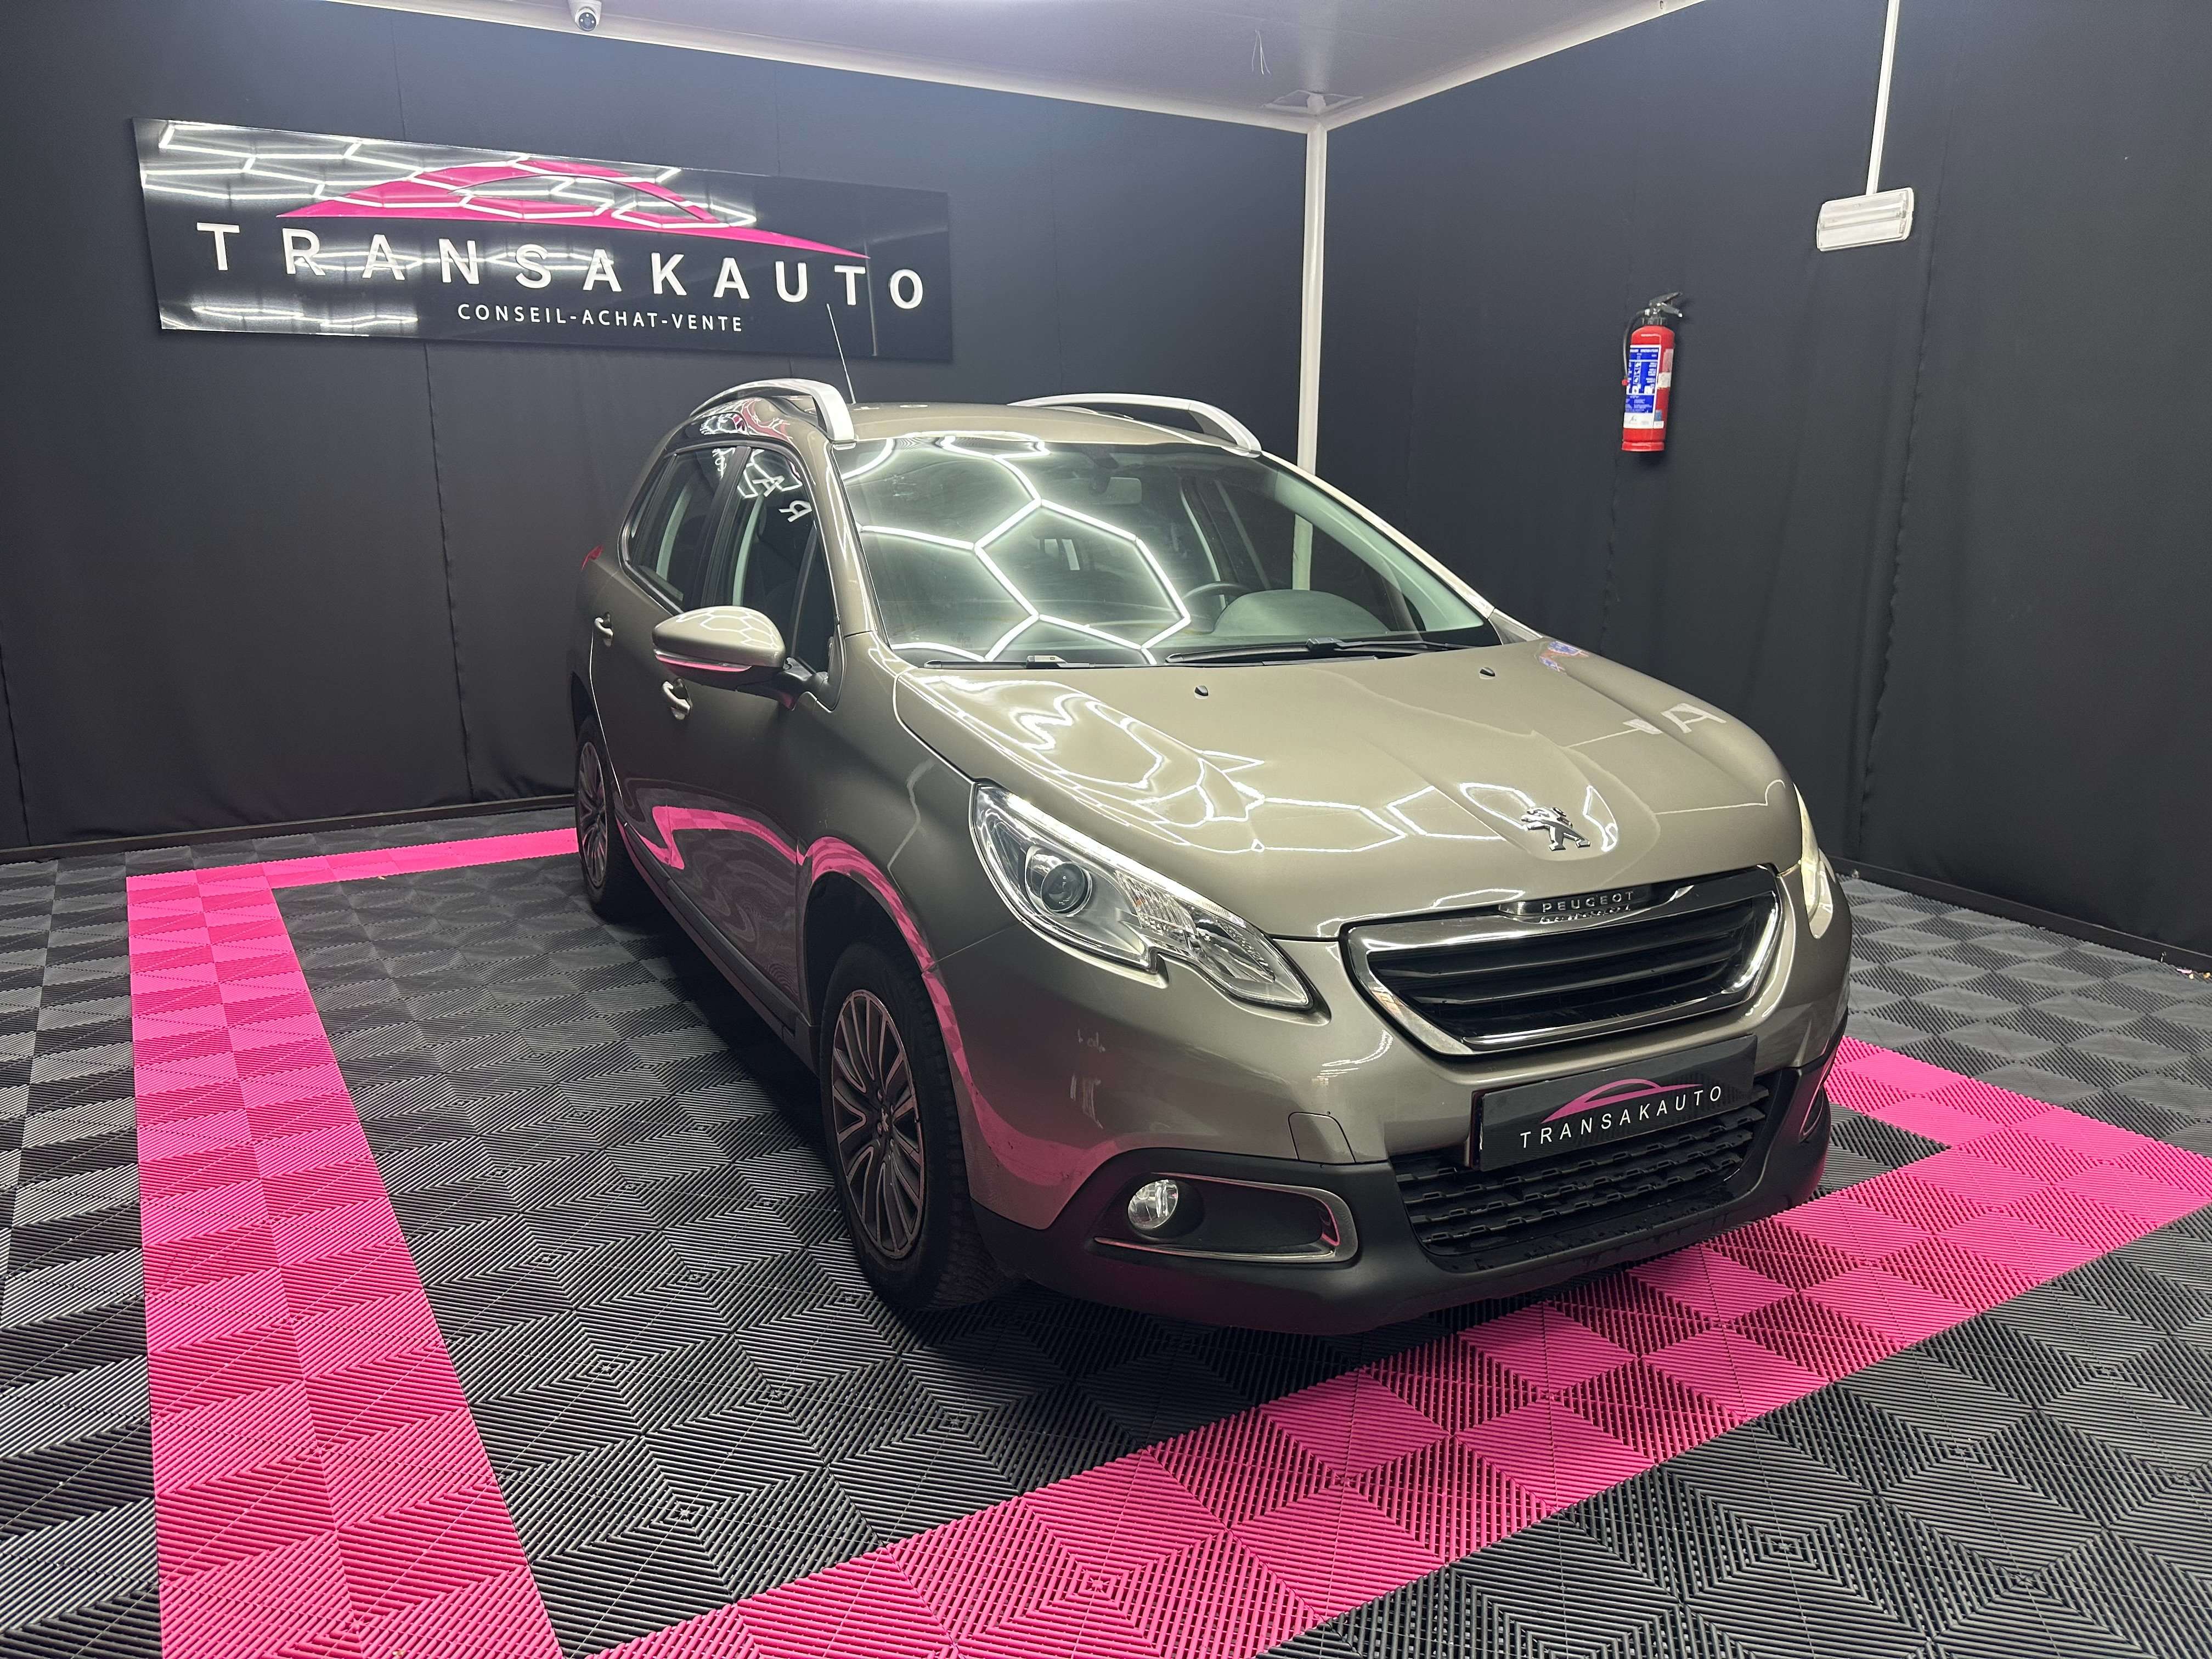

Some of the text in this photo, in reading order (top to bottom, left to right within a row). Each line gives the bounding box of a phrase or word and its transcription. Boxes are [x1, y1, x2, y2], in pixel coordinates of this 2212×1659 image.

[196, 222, 923, 309] TRANSAKAUTO
[457, 303, 742, 332] CONSEIL-ACHAT-VENTE
[1542, 891, 1633, 913] PEUGEOT
[1519, 1085, 1722, 1149] TRANSAKAUTO
